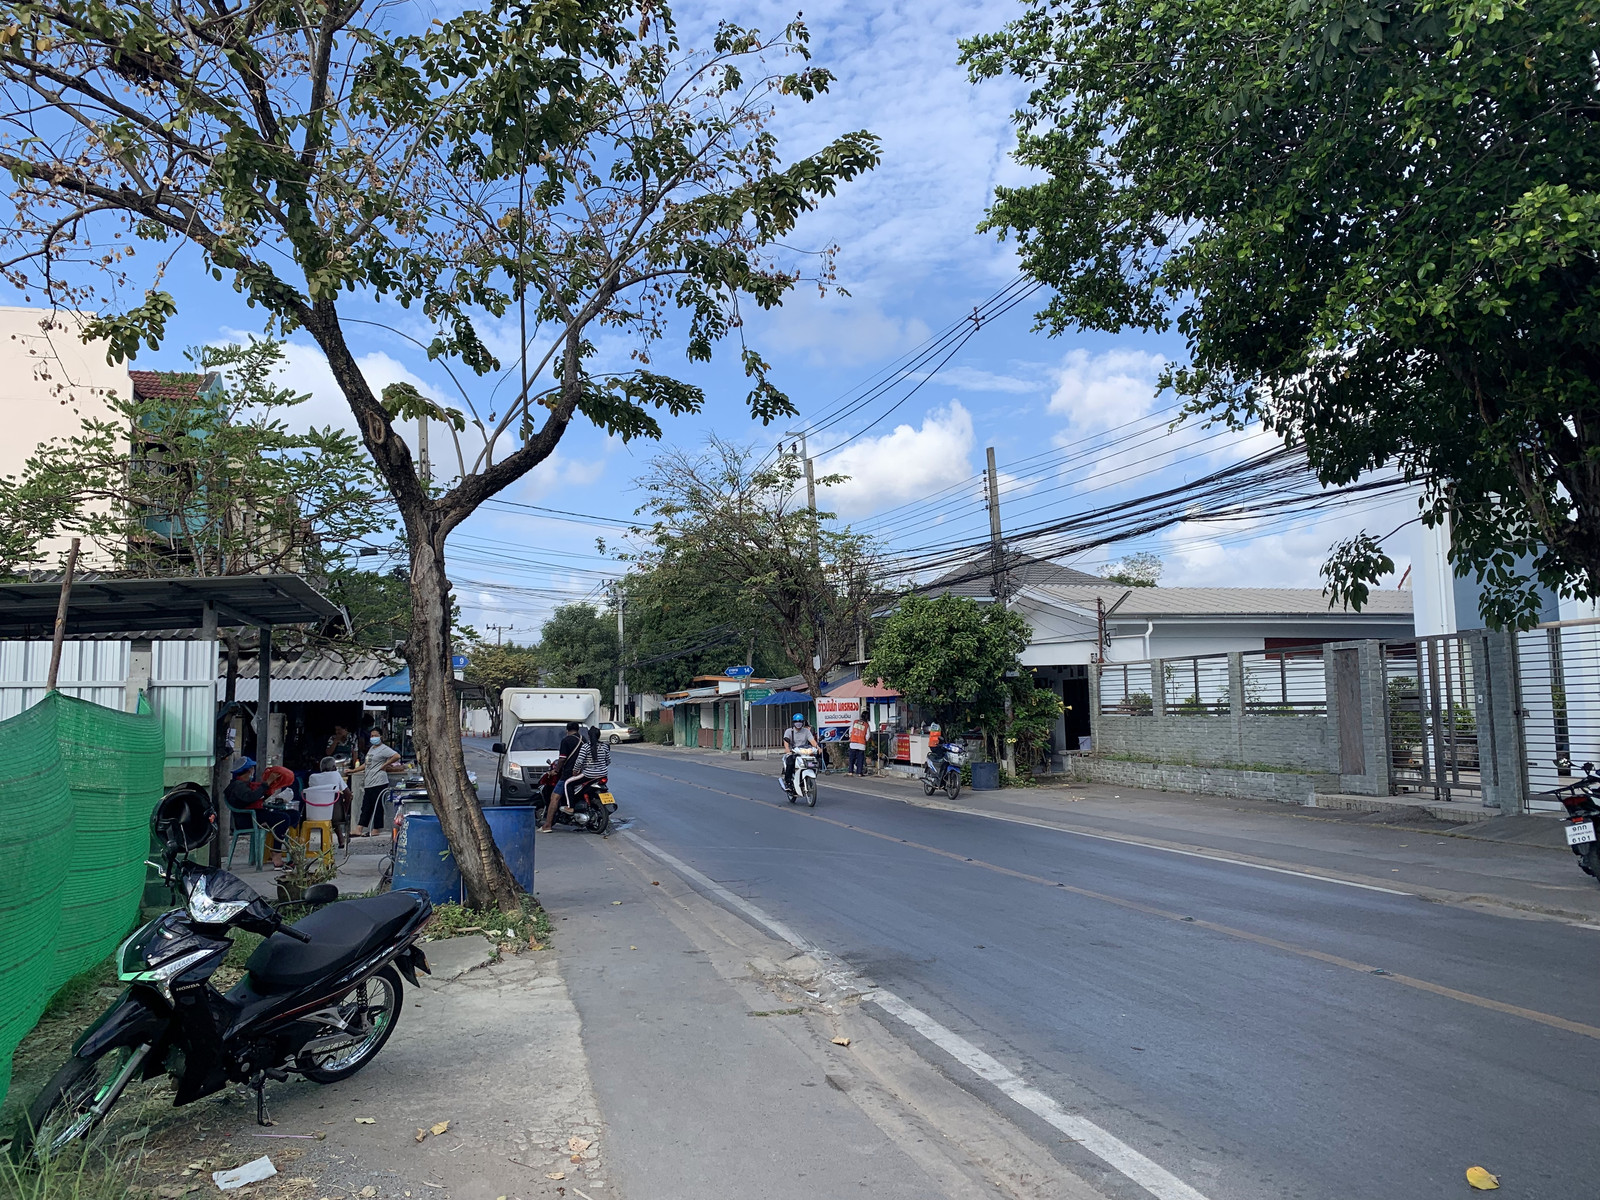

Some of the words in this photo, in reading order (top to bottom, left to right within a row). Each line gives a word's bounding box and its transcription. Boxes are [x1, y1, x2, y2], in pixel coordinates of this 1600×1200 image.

[459, 657, 464, 665] 9
[1572, 835, 1590, 843] 6101
[176, 983, 200, 992] HONDA
